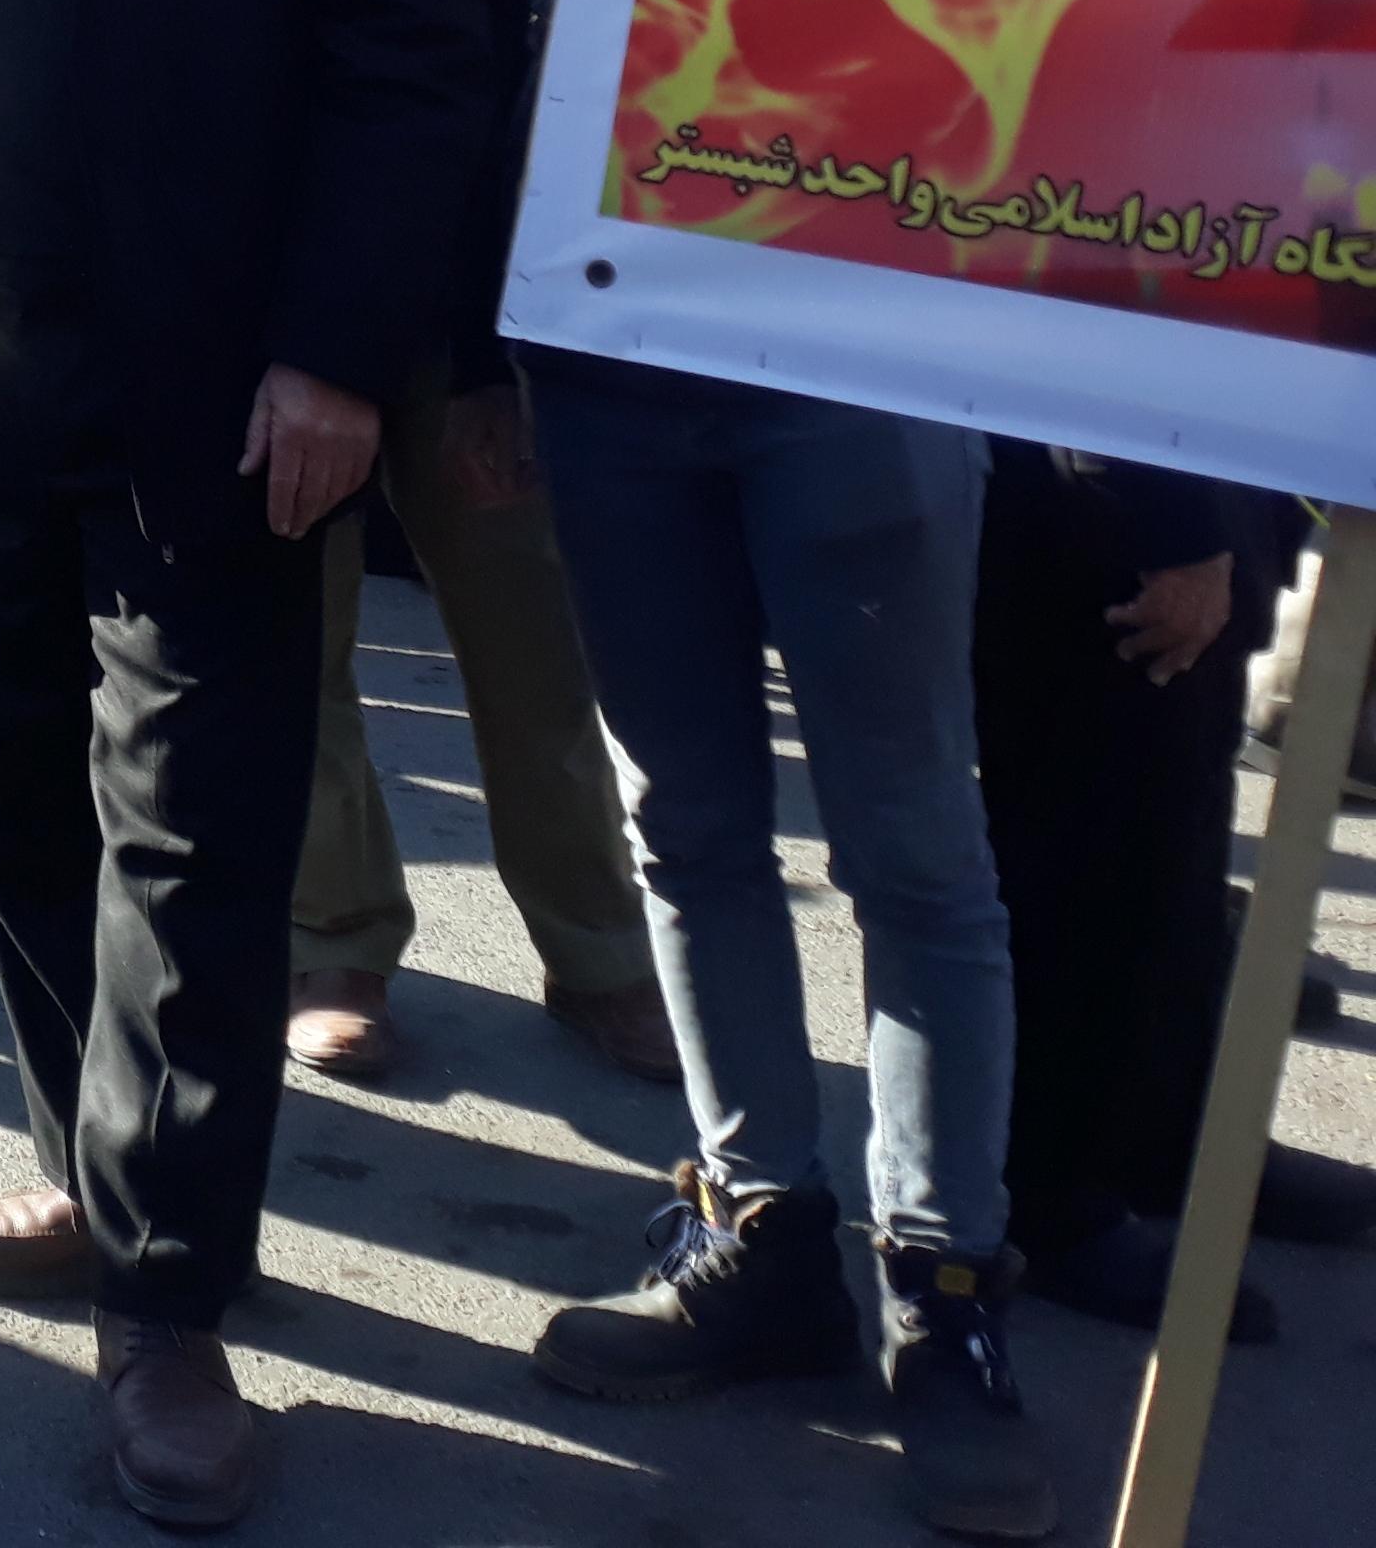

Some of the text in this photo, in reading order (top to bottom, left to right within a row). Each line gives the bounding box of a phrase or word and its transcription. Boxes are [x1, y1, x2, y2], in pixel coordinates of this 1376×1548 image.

[637, 123, 799, 197] شبستر
[799, 154, 937, 229] واحد
[938, 173, 1144, 246] اسلامی
[1141, 201, 1279, 280] آزاد
